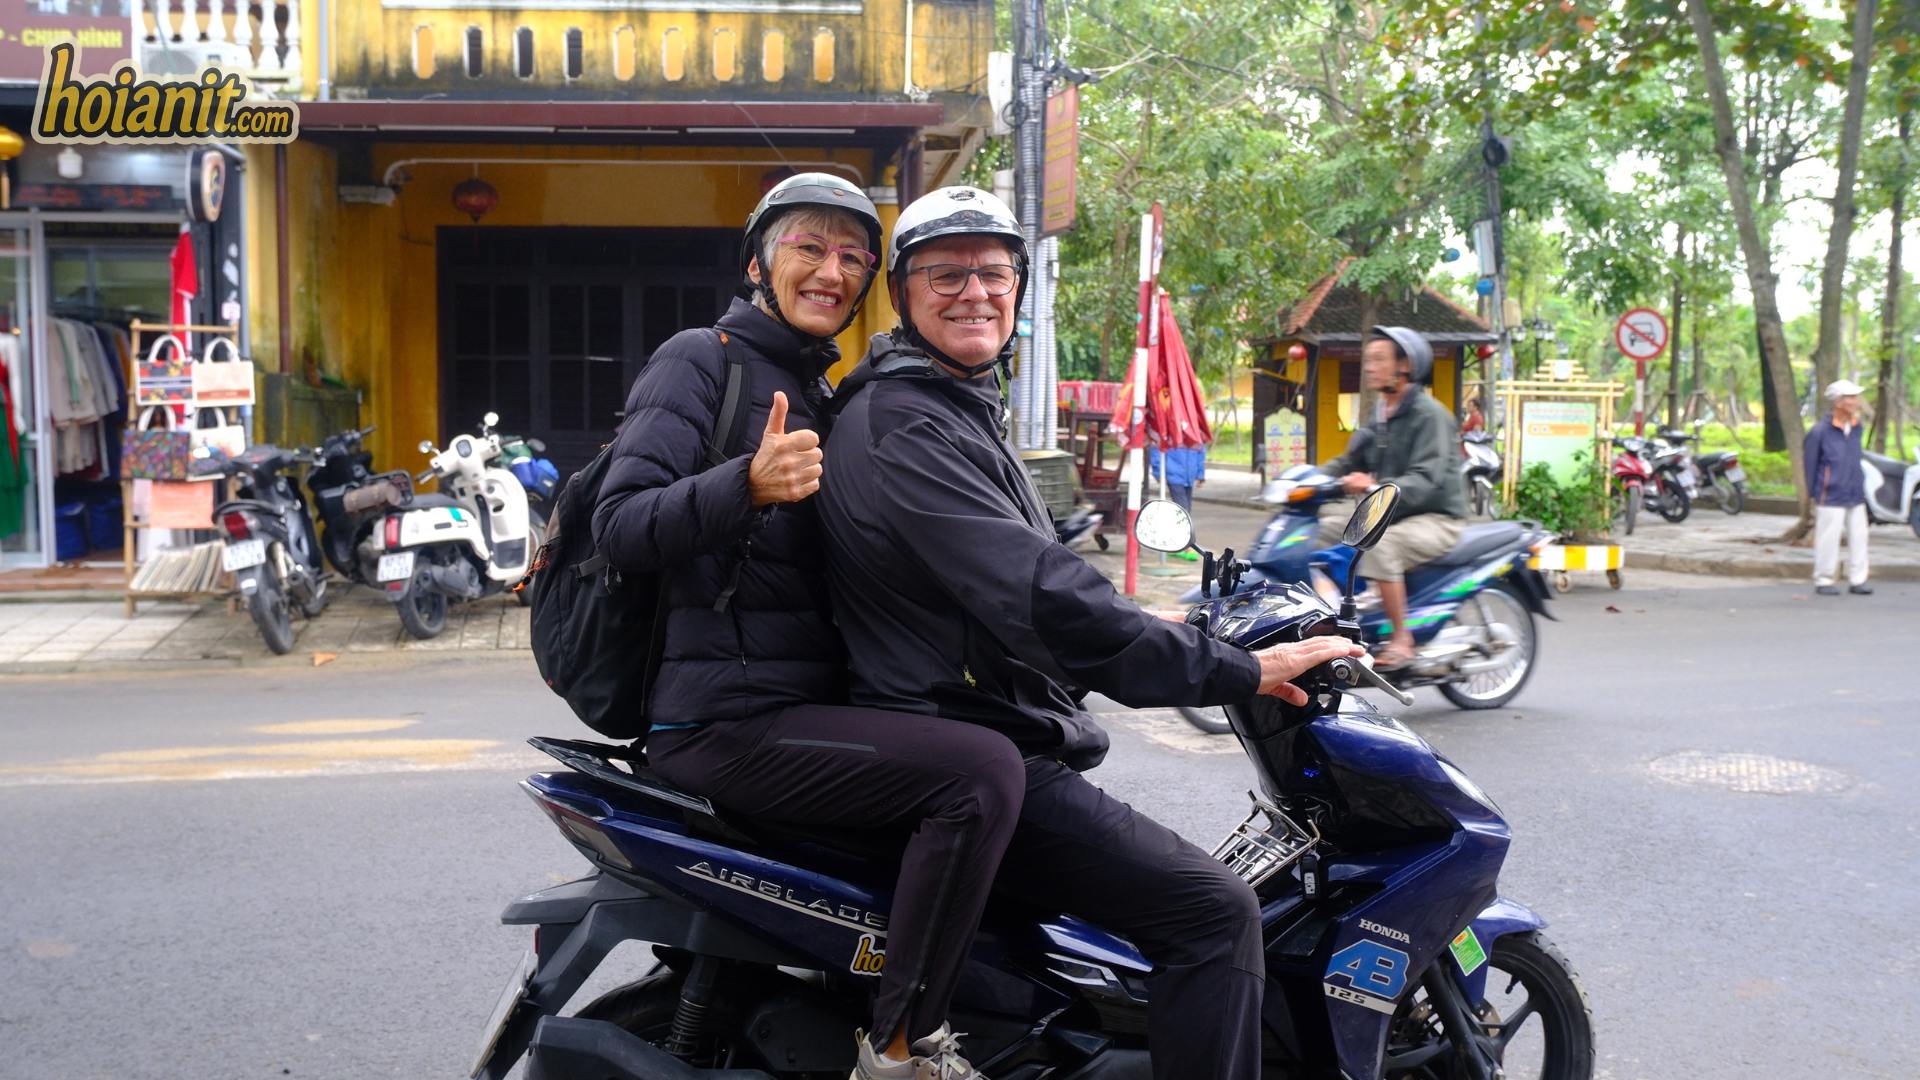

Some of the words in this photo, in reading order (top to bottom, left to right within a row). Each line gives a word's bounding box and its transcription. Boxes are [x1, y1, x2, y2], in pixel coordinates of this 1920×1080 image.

[689, 861, 888, 928] AIRBLADE
[1359, 918, 1410, 944] HONDA
[1324, 939, 1410, 999] AB
[1329, 986, 1367, 1004] 125
